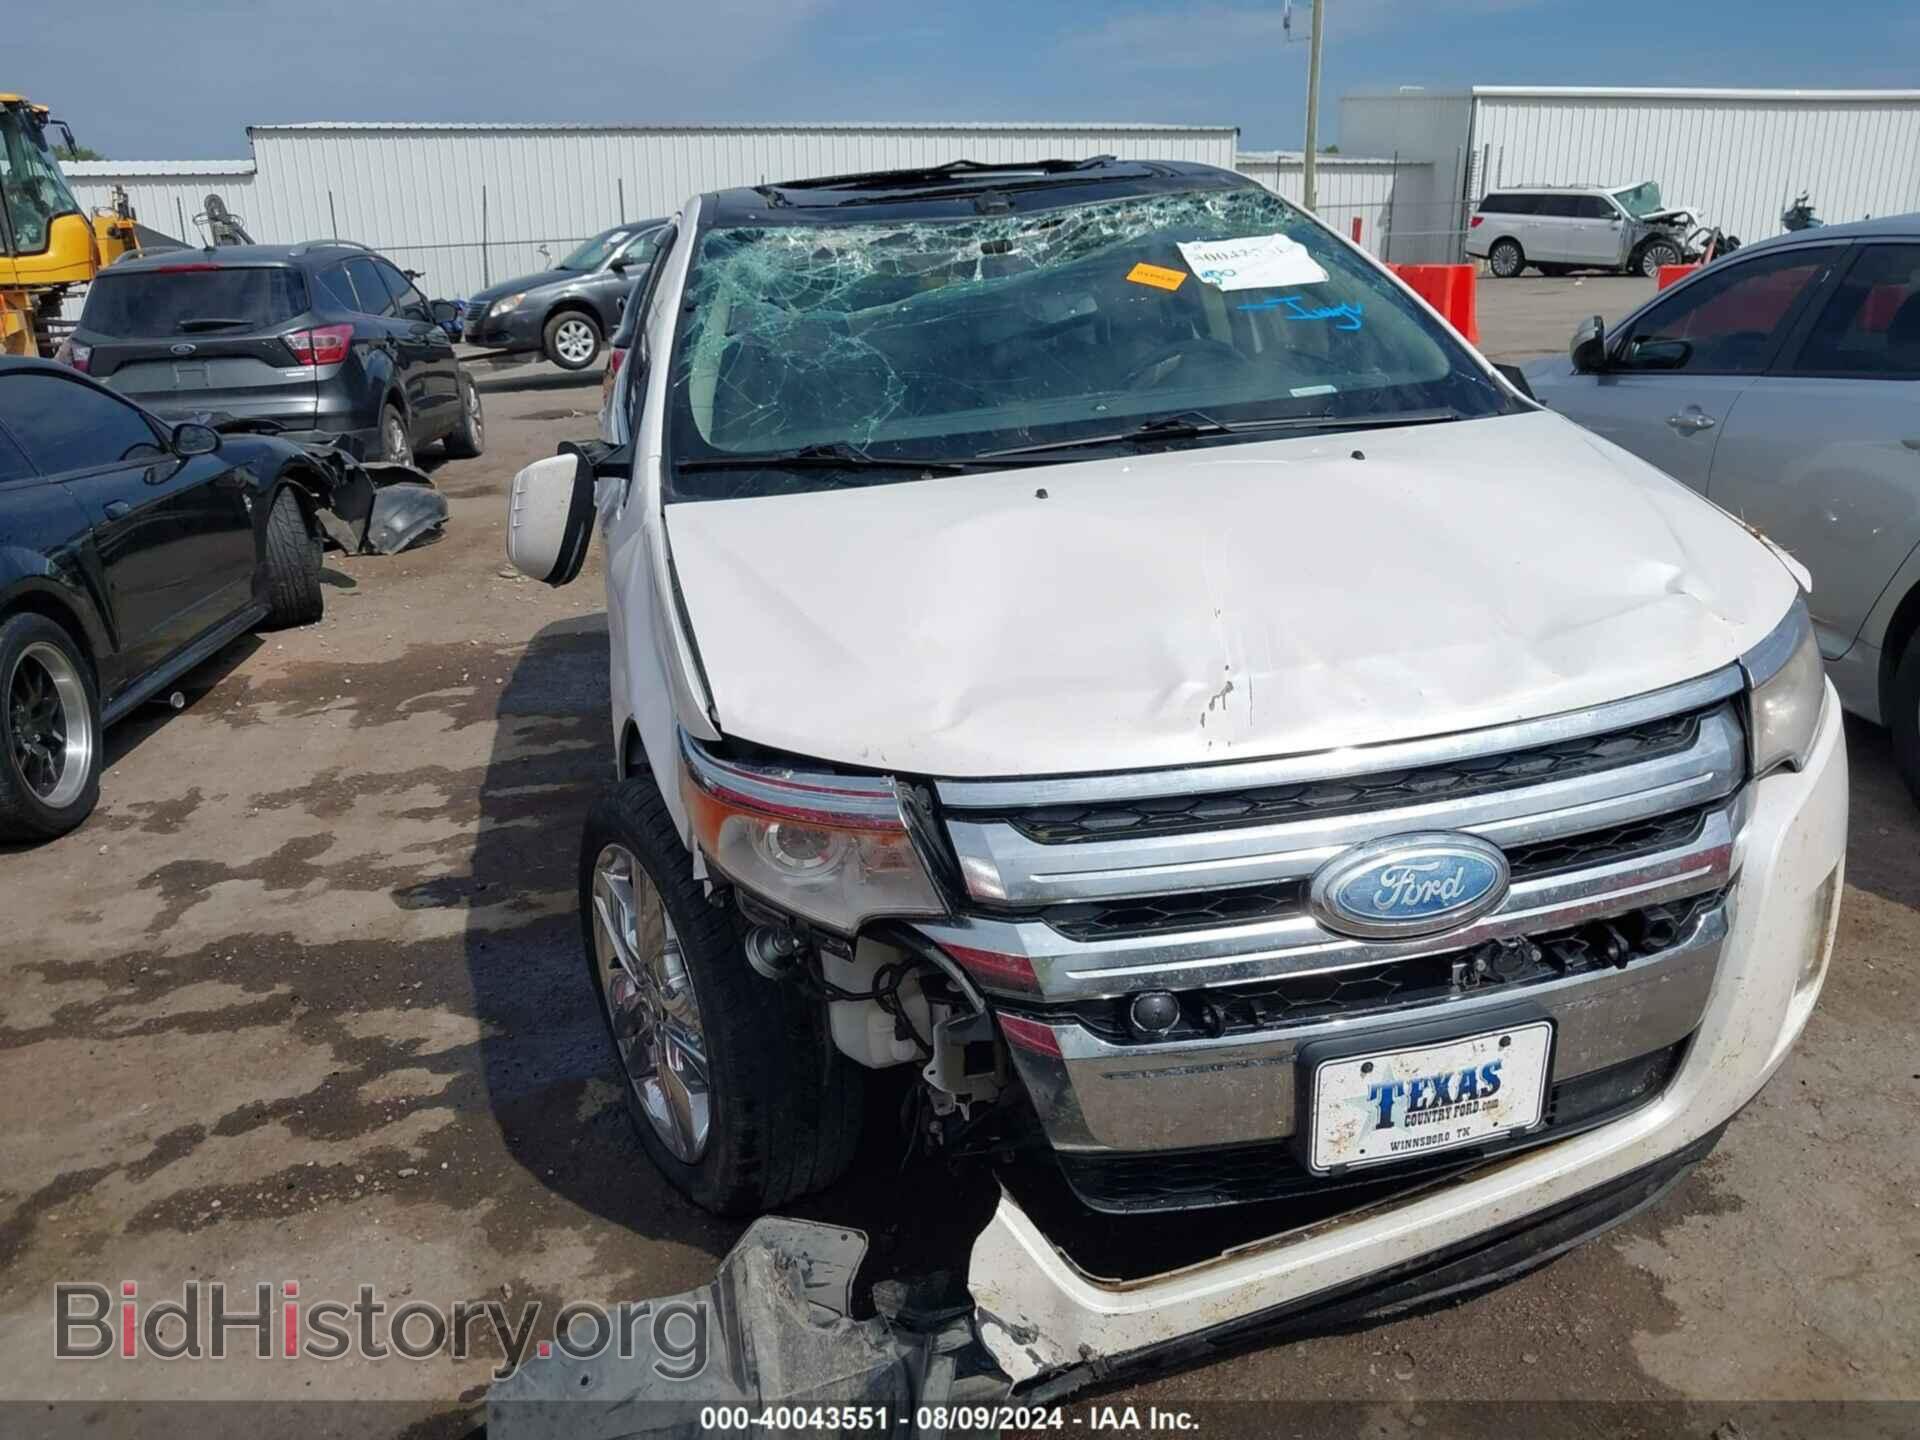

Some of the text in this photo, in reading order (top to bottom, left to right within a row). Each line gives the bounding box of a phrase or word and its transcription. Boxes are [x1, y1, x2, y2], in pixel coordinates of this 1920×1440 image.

[1373, 861, 1466, 912] Ford
[1367, 1058, 1503, 1130] TEXAS
[1404, 1106, 1453, 1128] COUNTRY
[1389, 1126, 1471, 1152] WINNSBORO TX
